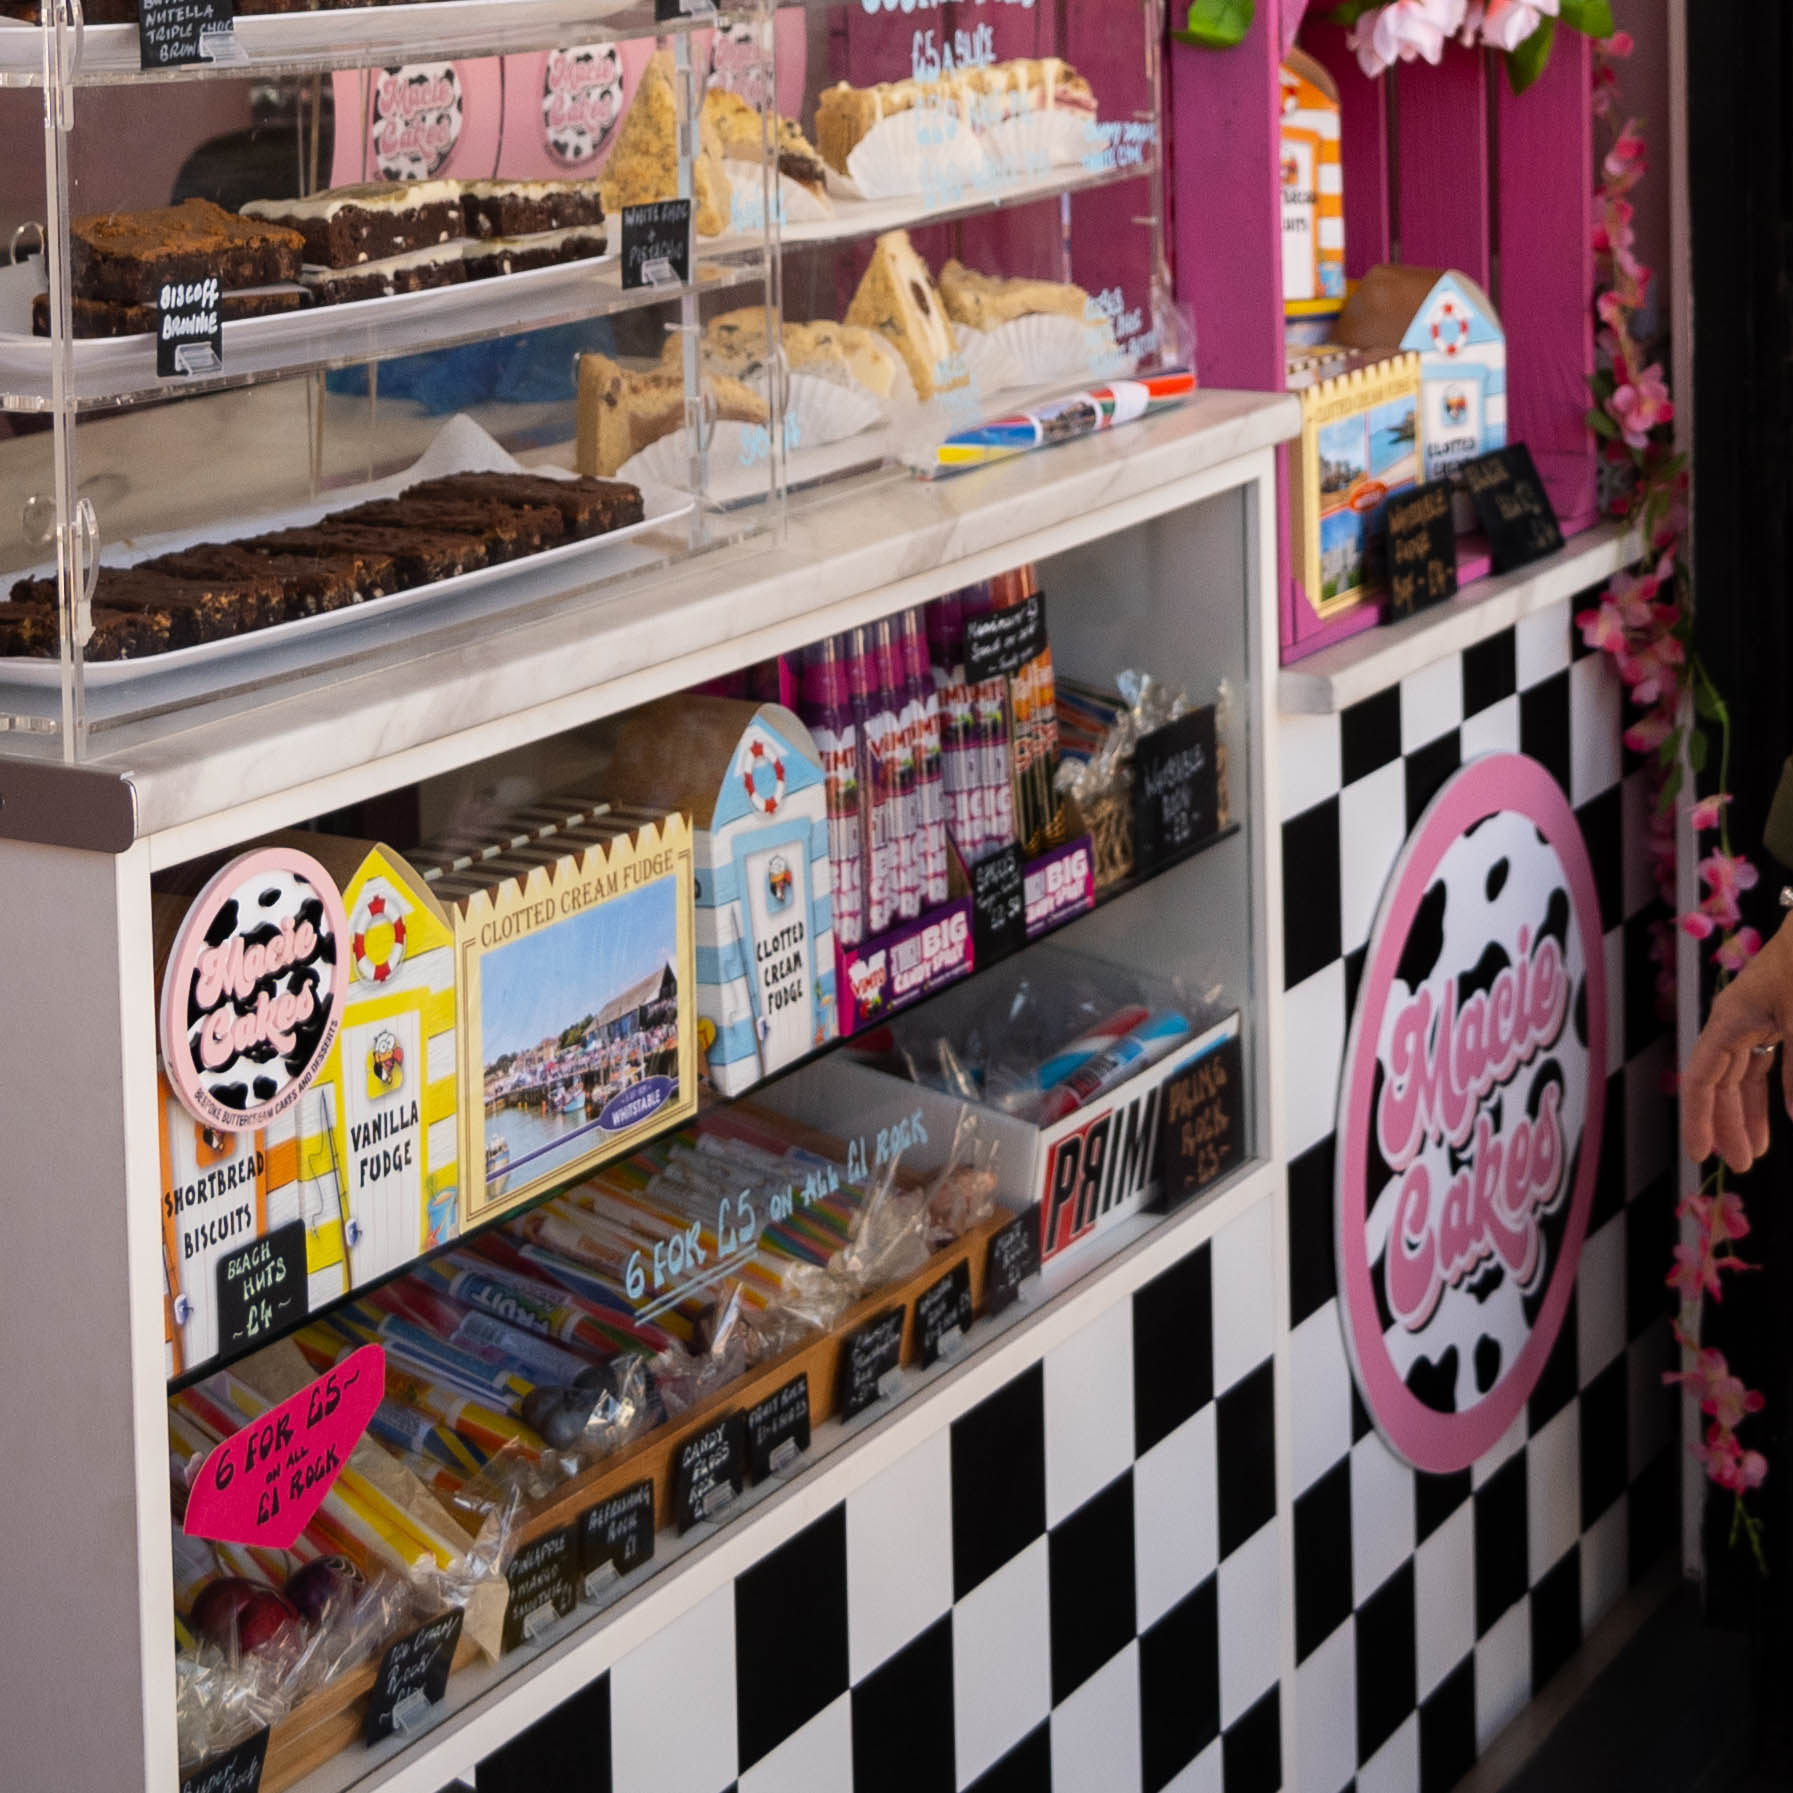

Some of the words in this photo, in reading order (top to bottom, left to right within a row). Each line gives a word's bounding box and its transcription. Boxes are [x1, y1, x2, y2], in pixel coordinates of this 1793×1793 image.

[146, 5, 214, 27] NUTELLA
[147, 23, 193, 44] TRIPLE
[161, 278, 219, 310] BISCOFF
[162, 310, 218, 340] BROWNIE
[1047, 848, 1088, 893] BIG
[481, 898, 556, 948] CLOTTED
[560, 872, 618, 914] CREAM
[623, 848, 674, 889] FUDGE
[757, 921, 804, 962] CLOTTED
[922, 910, 968, 954] BIG
[196, 915, 318, 1009] Macie
[764, 950, 802, 986] CREAM
[768, 978, 803, 1015] FUDGE
[201, 978, 315, 1069] Cakes
[275, 1091, 298, 1116] CAKES
[298, 1071, 313, 1094] AND
[311, 1019, 339, 1075] DESSERTS
[1378, 924, 1565, 1171] Macie
[350, 1100, 419, 1153] VANILLA
[611, 1088, 661, 1127] WHITSTABLE
[164, 1150, 265, 1219] SHORTBREAD
[359, 1139, 412, 1188] FUDGE
[625, 1250, 645, 1300] 6
[653, 1220, 706, 1290] FOR
[717, 1188, 756, 1258] £5
[769, 1184, 793, 1221] ON
[800, 1164, 840, 1207] ALL
[847, 1136, 868, 1185] £1
[875, 1107, 928, 1165] ROCK
[1386, 1080, 1566, 1333] Cakes
[184, 1203, 252, 1259] BISCUITS
[227, 1239, 271, 1281] BEACH
[242, 1258, 286, 1302] HUTS
[215, 1448, 234, 1491] 6
[245, 1413, 295, 1473] FOR
[265, 1463, 281, 1485] ON
[286, 1446, 310, 1470] ALL
[682, 1422, 727, 1469] CANDY
[256, 1487, 280, 1526] £1
[289, 1444, 340, 1501] ROCK
